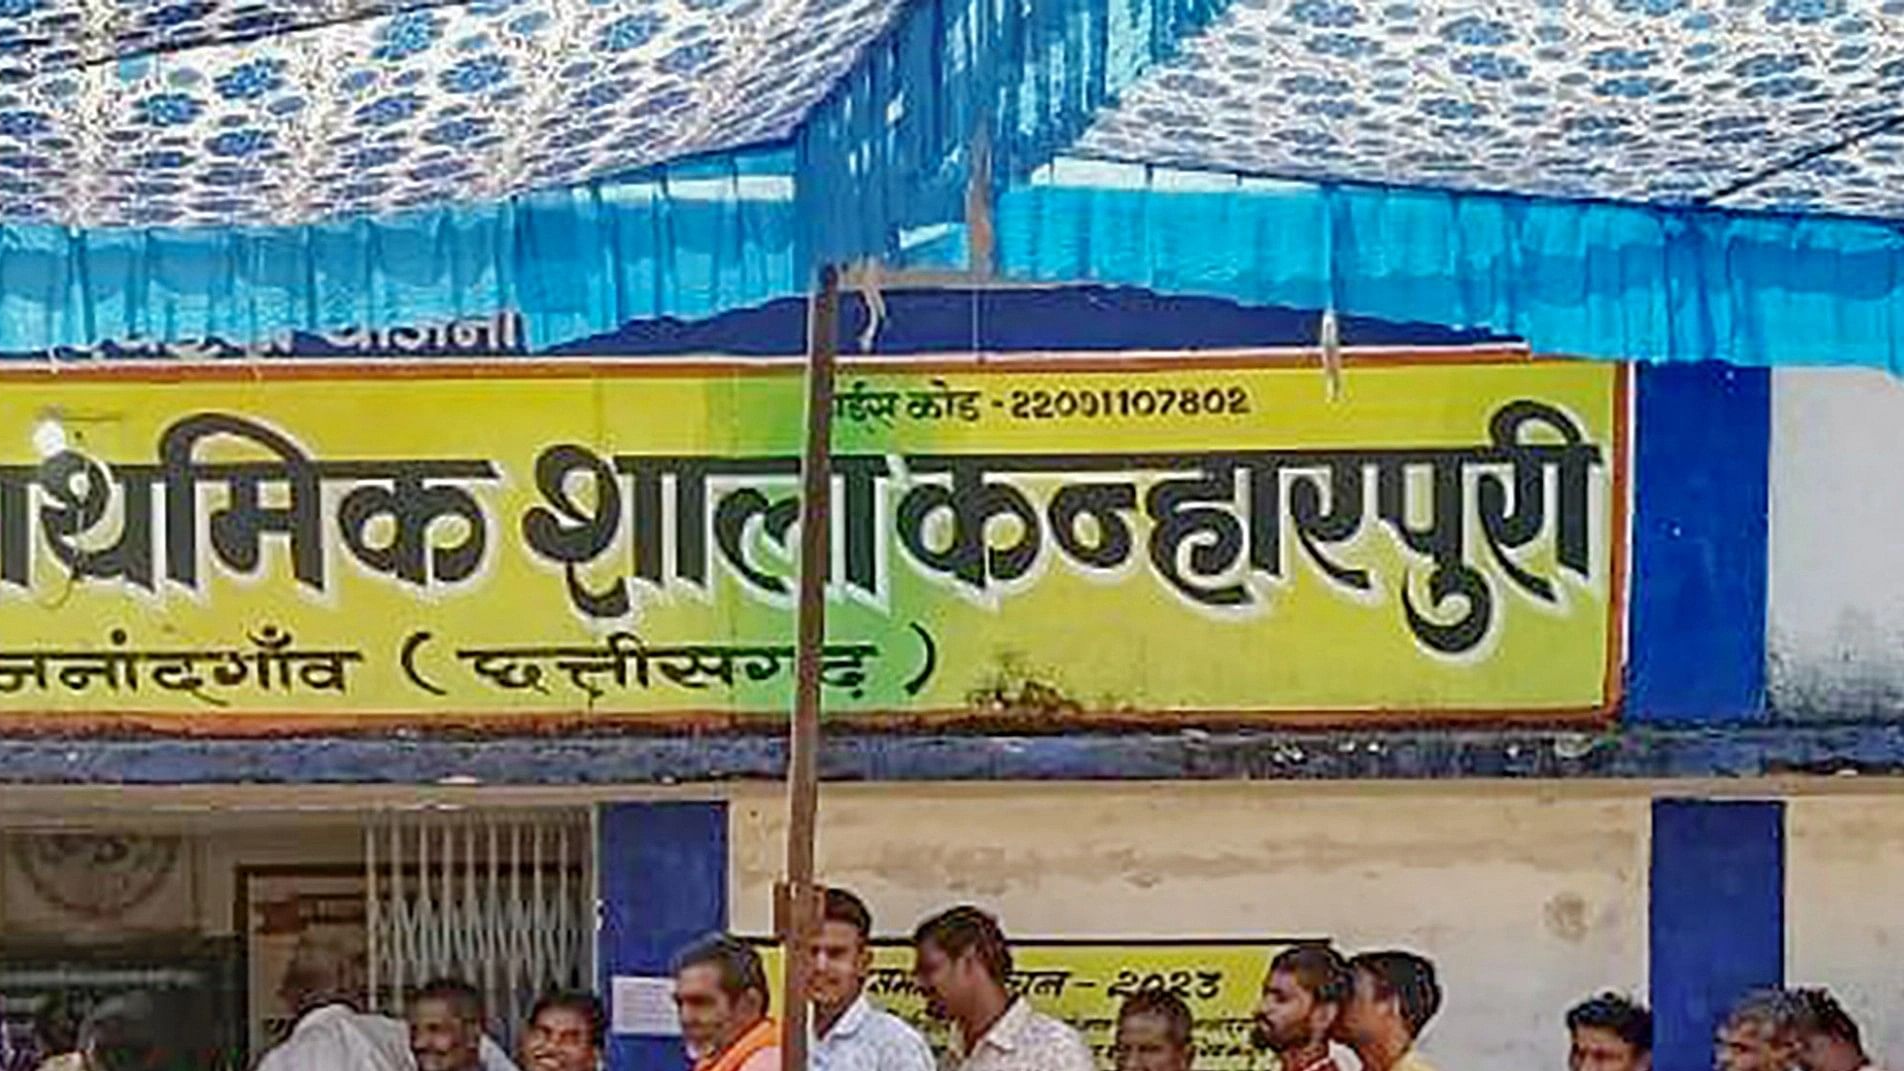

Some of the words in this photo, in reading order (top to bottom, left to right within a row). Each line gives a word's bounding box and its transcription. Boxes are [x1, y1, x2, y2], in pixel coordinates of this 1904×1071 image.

[906, 380, 982, 421] कोड
[521, 443, 888, 618] शाला
[892, 400, 1604, 652] कन्हारपुरी
